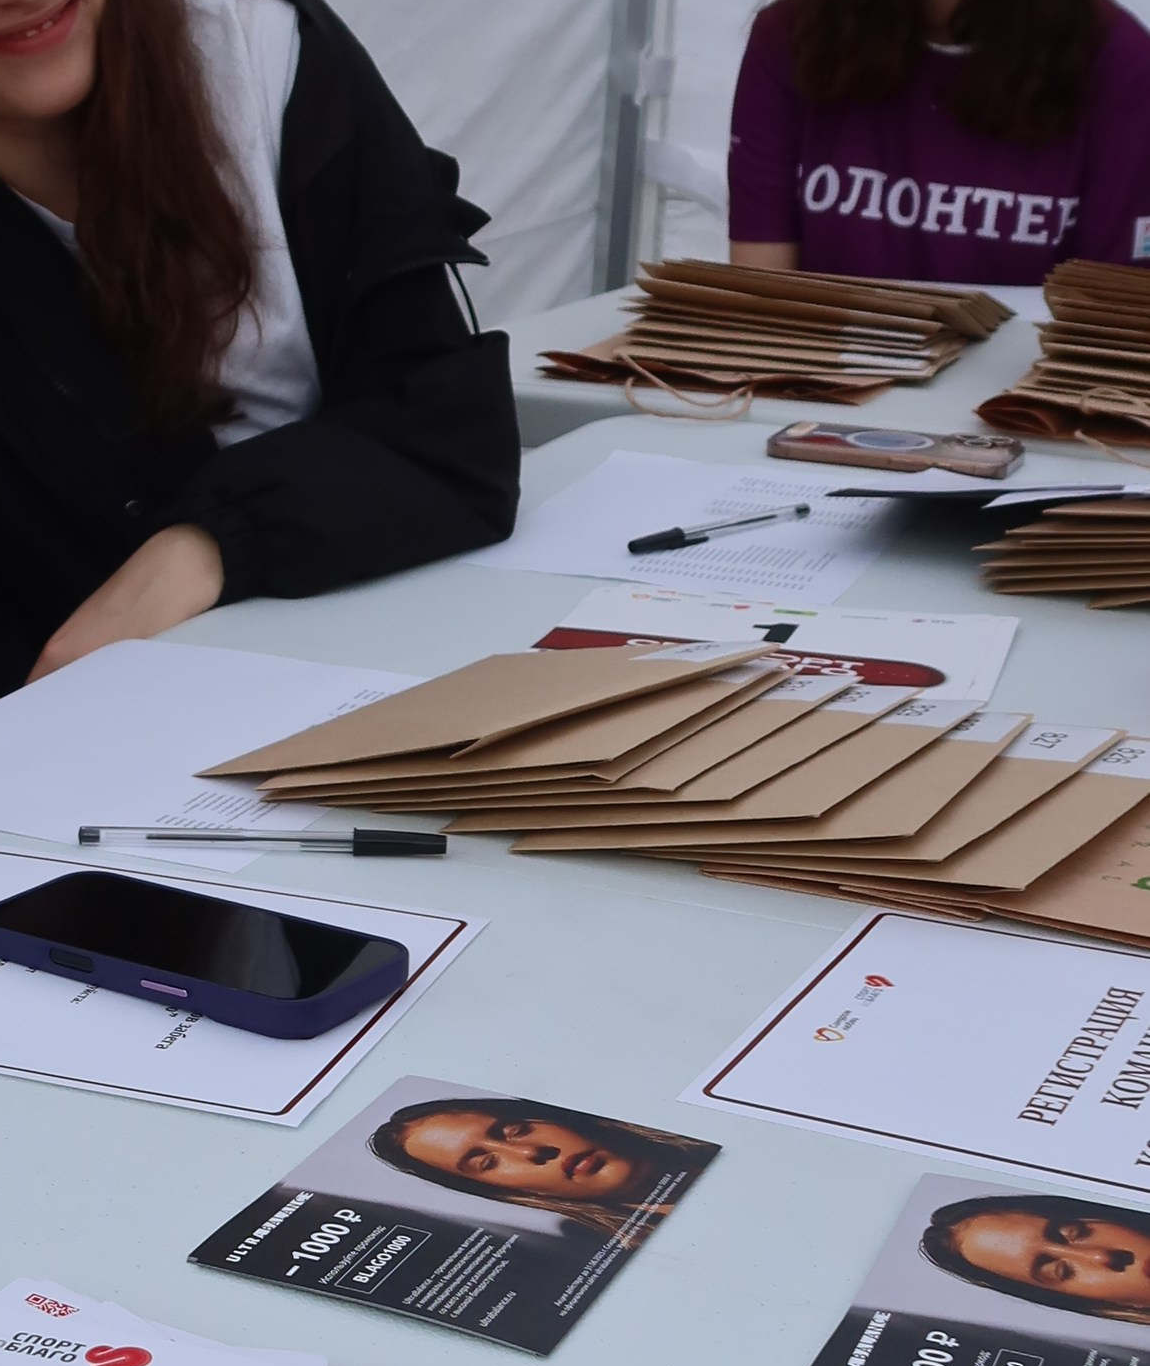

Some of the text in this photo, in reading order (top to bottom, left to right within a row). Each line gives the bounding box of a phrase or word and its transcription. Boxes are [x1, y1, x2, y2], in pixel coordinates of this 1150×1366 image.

[1028, 731, 1070, 750] 827
[1102, 745, 1145, 766] 826
[1016, 986, 1145, 1126] РЕГИСТРАЦИЯ
[291, 1223, 350, 1260] 1000
[353, 1233, 412, 1286] BLAGO1000
[12, 1332, 86, 1352] СПОРТ
